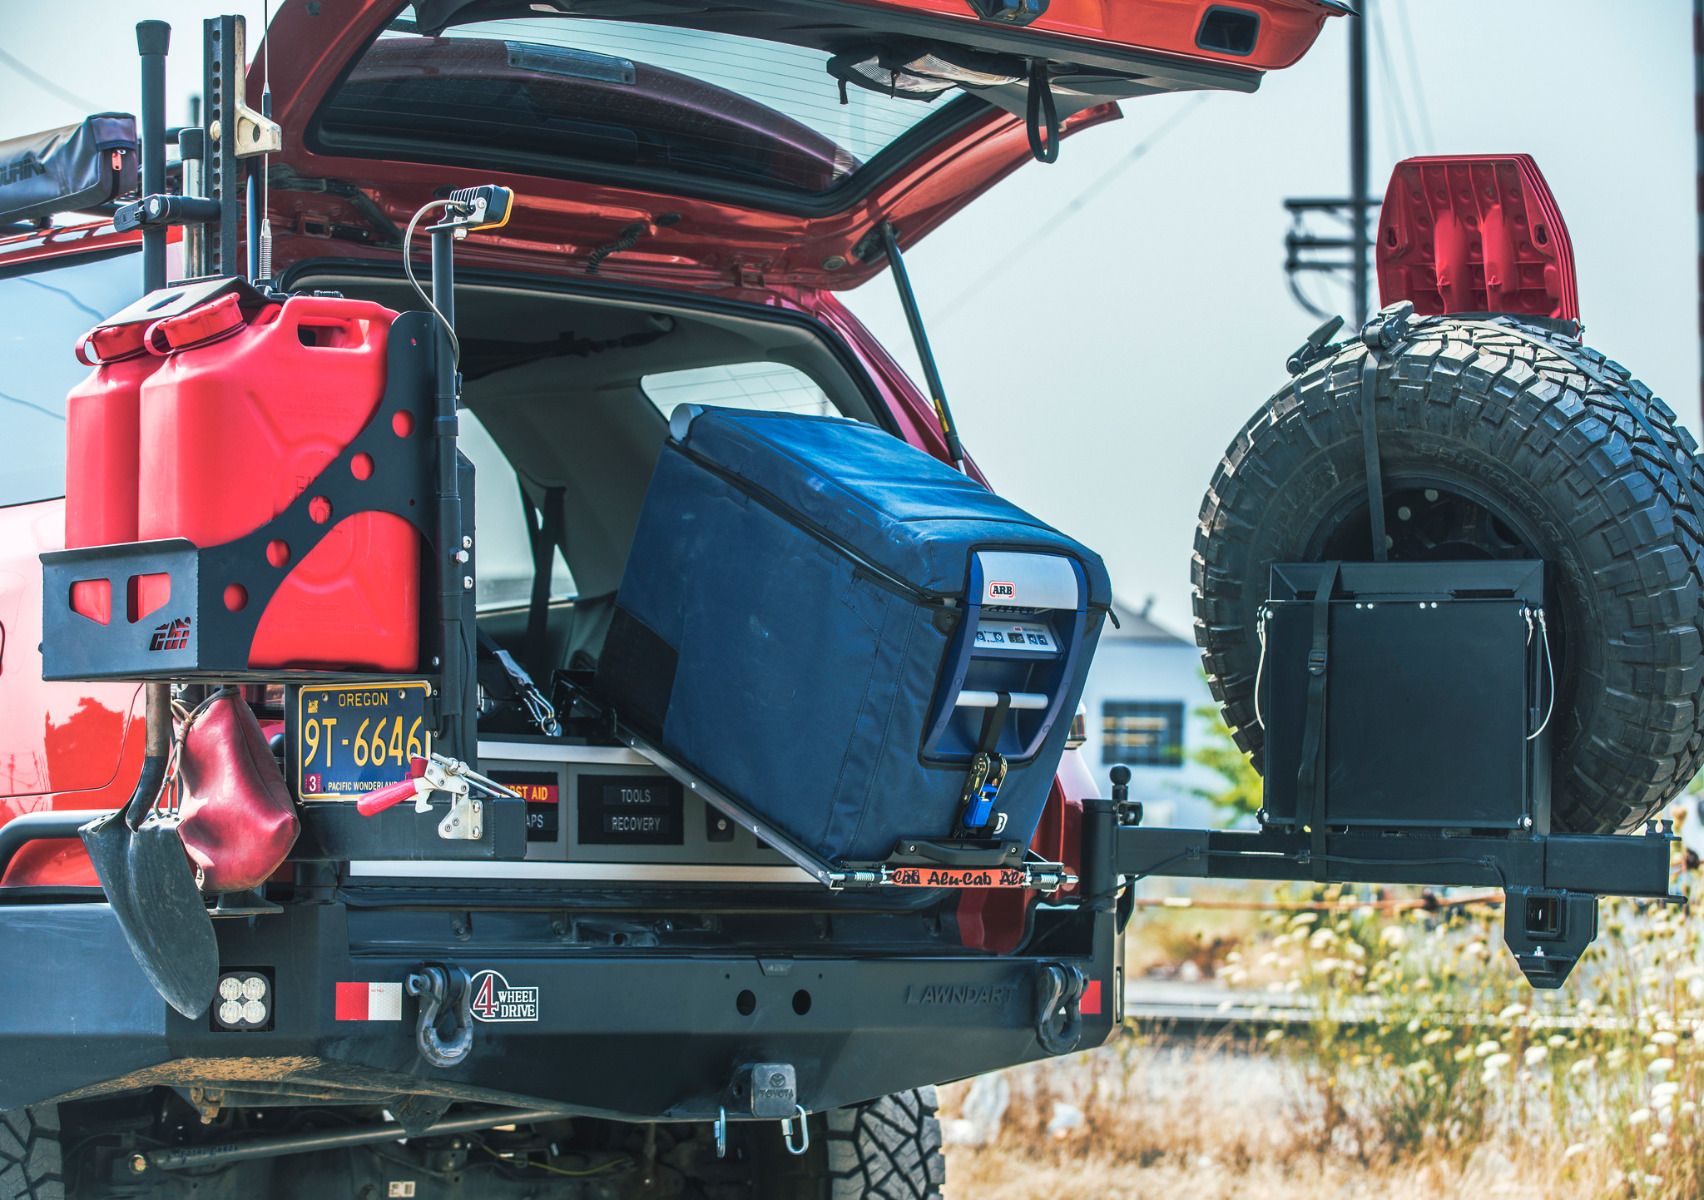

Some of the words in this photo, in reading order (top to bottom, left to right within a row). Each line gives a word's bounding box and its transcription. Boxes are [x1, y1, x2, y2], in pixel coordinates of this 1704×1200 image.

[992, 585, 1012, 594] ARB
[338, 692, 389, 707] OREGON
[304, 716, 422, 768] 9T-6646
[309, 775, 317, 792] 3
[327, 782, 352, 791] PACIFIC
[353, 781, 398, 791] WONDERL
[531, 786, 548, 801] AID
[621, 789, 651, 803] TOOLS
[526, 813, 544, 829] APS
[611, 816, 661, 831] RECOVERY
[927, 870, 992, 886] Alu-Cab
[473, 974, 500, 1018] 4
[497, 990, 536, 1003] WHEEL
[904, 983, 1018, 1005] LAWNDART
[500, 1004, 536, 1018] DRIVE
